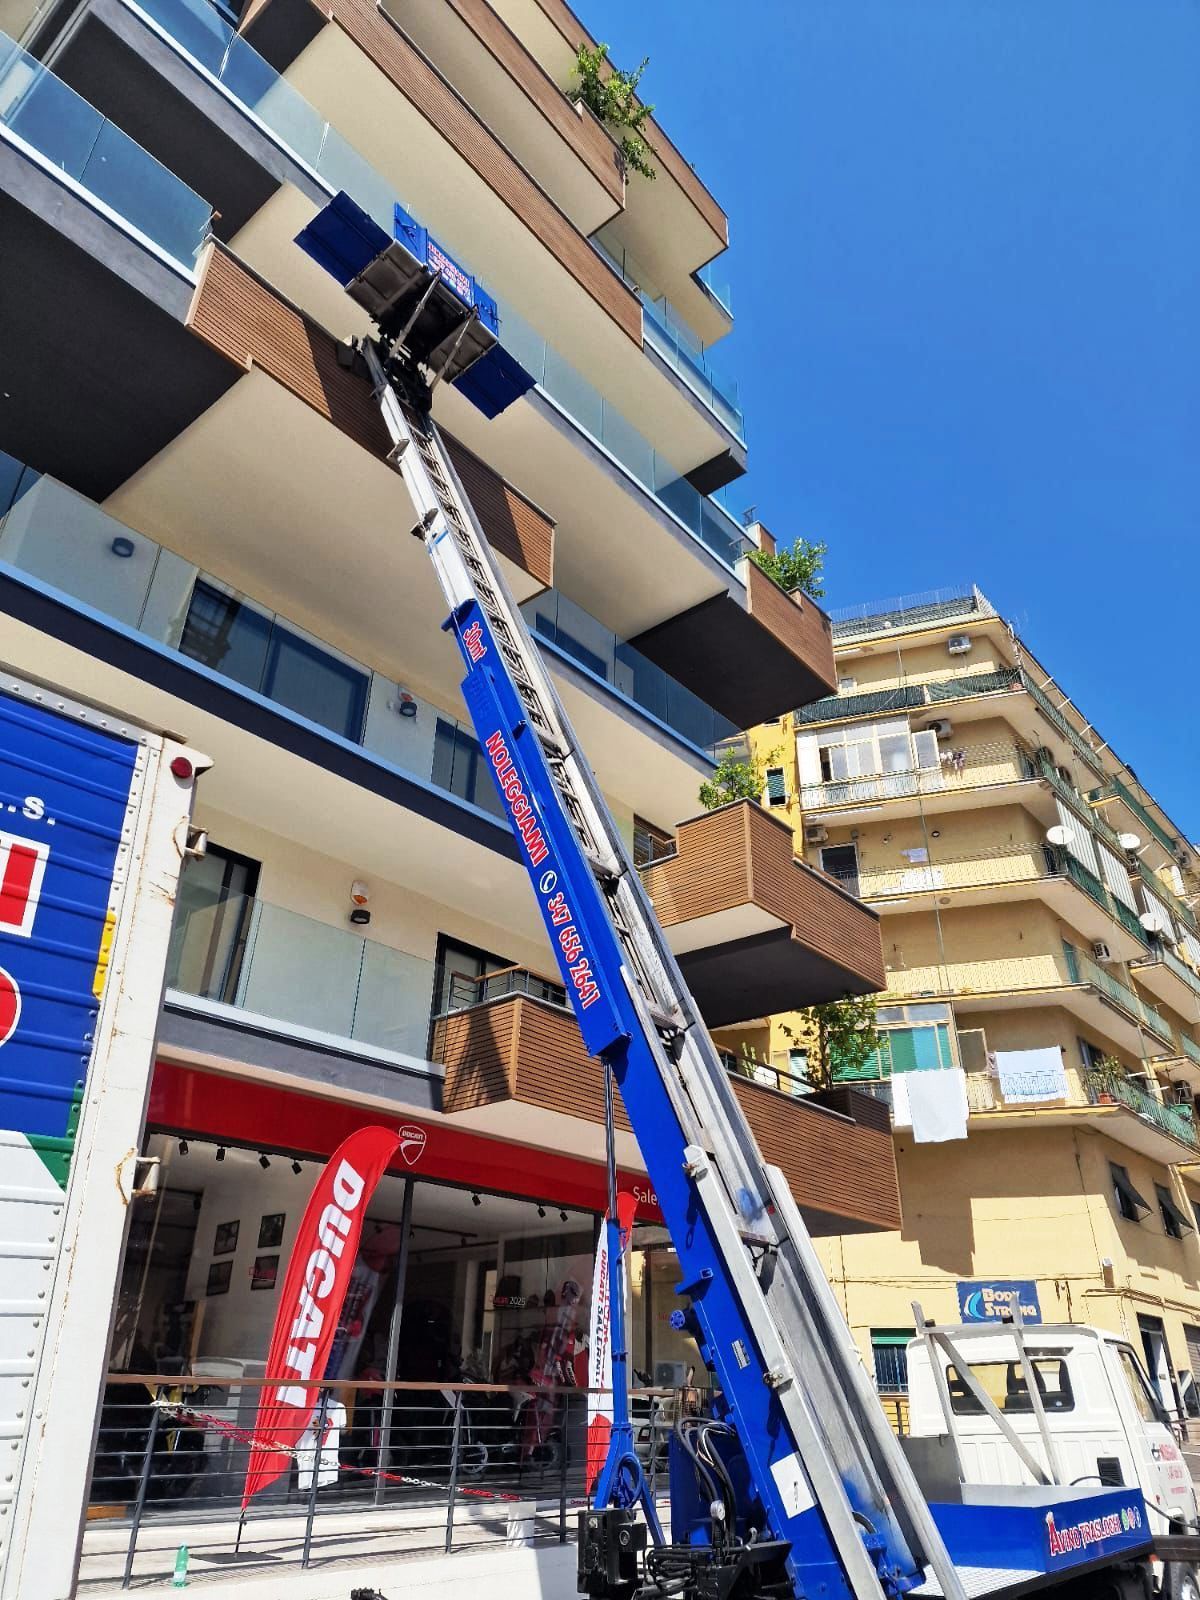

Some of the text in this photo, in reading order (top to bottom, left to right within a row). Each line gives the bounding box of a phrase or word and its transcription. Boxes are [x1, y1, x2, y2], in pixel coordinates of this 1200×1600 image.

[485, 730, 601, 1010] NOLEGGIAMI 347 656 2641
[402, 1129, 424, 1141] DUCATI
[633, 1185, 660, 1206] Sale
[275, 1158, 366, 1409] DUCATI
[597, 1248, 607, 1303] DUCATI
[509, 1296, 526, 1306] 2025
[984, 1302, 1037, 1317] STRNG
[1046, 1511, 1081, 1556] AVINO
